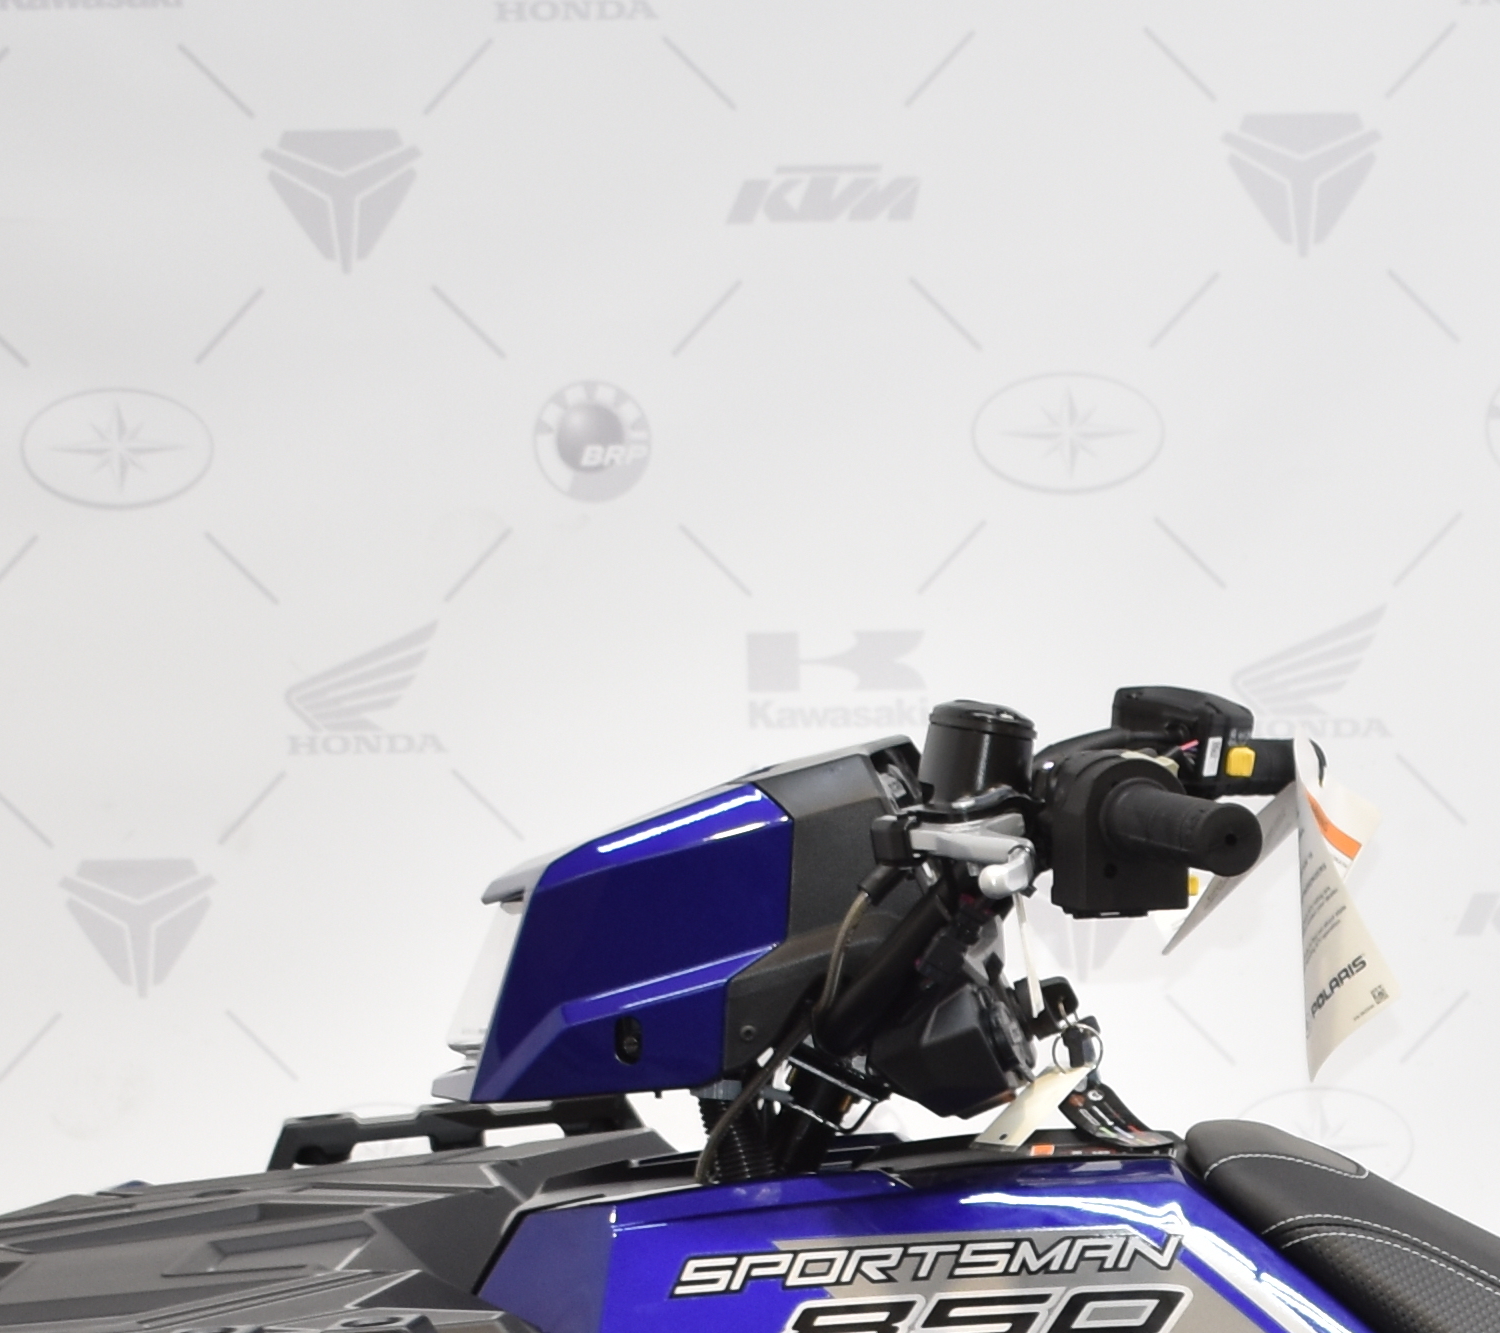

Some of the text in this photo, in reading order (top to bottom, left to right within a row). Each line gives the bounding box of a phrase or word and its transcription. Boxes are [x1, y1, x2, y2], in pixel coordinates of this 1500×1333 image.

[495, 0, 655, 22] HONDA
[727, 163, 919, 224] KTM
[580, 443, 647, 465] BRP
[746, 698, 925, 730] Kawasaki
[287, 735, 448, 755] HONDA
[1311, 954, 1367, 1020] POLARIS
[671, 1233, 1184, 1298] SPORTSMAN
